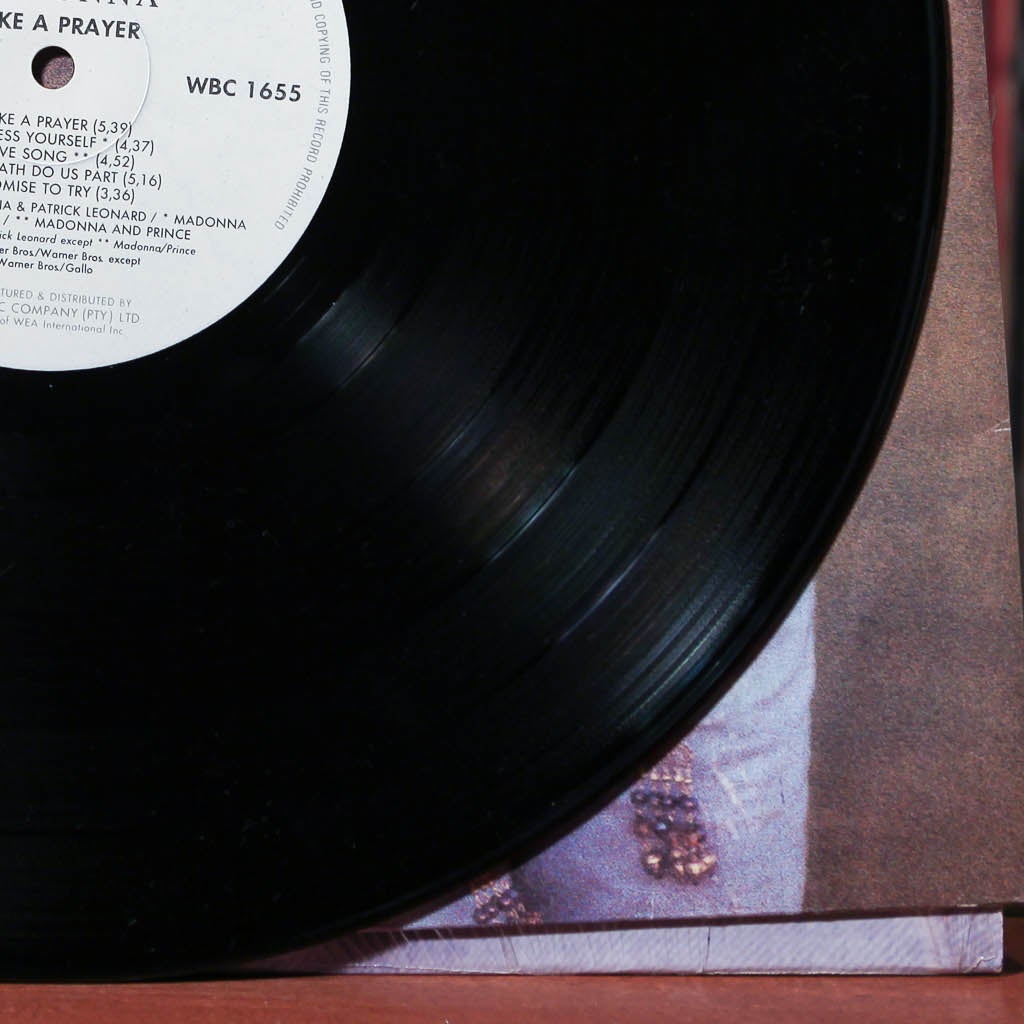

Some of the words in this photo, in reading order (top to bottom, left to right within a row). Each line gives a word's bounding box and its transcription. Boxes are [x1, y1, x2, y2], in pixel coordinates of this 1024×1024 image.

[32, 14, 48, 32] A
[58, 16, 141, 40] PRAYER
[314, 14, 331, 64] COPYING
[186, 76, 236, 96] WBC
[248, 80, 301, 102] 1655
[320, 70, 331, 84] OF
[318, 89, 330, 114] THIS
[20, 114, 31, 126] A
[37, 116, 88, 131] PRAYER
[93, 119, 132, 138] (5,39)
[26, 132, 97, 148] YOURSELF
[114, 138, 154, 156] (4,37)
[306, 118, 326, 164] RECORD
[22, 148, 67, 162] SONG
[96, 153, 135, 172] (4,52)
[32, 166, 54, 178] DO
[60, 168, 78, 180] US
[84, 170, 118, 184] PART
[123, 172, 162, 190] (5,16)
[43, 182, 61, 196] TO
[68, 184, 92, 198] TRY
[96, 186, 135, 204] (3,36)
[274, 167, 313, 231] PROHIBITED
[16, 202, 26, 212] &
[31, 202, 80, 217] PATRICK
[86, 206, 146, 222] LEONARD
[174, 214, 247, 230] MADONNA
[34, 218, 107, 233] MADONNA
[112, 224, 141, 236] AND
[146, 227, 191, 240] PRINCE
[17, 232, 56, 244] Leonard
[60, 238, 93, 248] except
[113, 240, 196, 256] Madonna/Prince
[108, 256, 141, 266] except
[37, 292, 45, 301] &
[50, 292, 114, 307] DISTRIBUTED
[120, 298, 132, 308] BY
[0, 316, 9, 326] of
[14, 318, 38, 328] WEA
[44, 320, 106, 334] International
[11, 303, 78, 318] COMPANY
[82, 309, 114, 324] (PTY)
[119, 313, 140, 324] LTD
